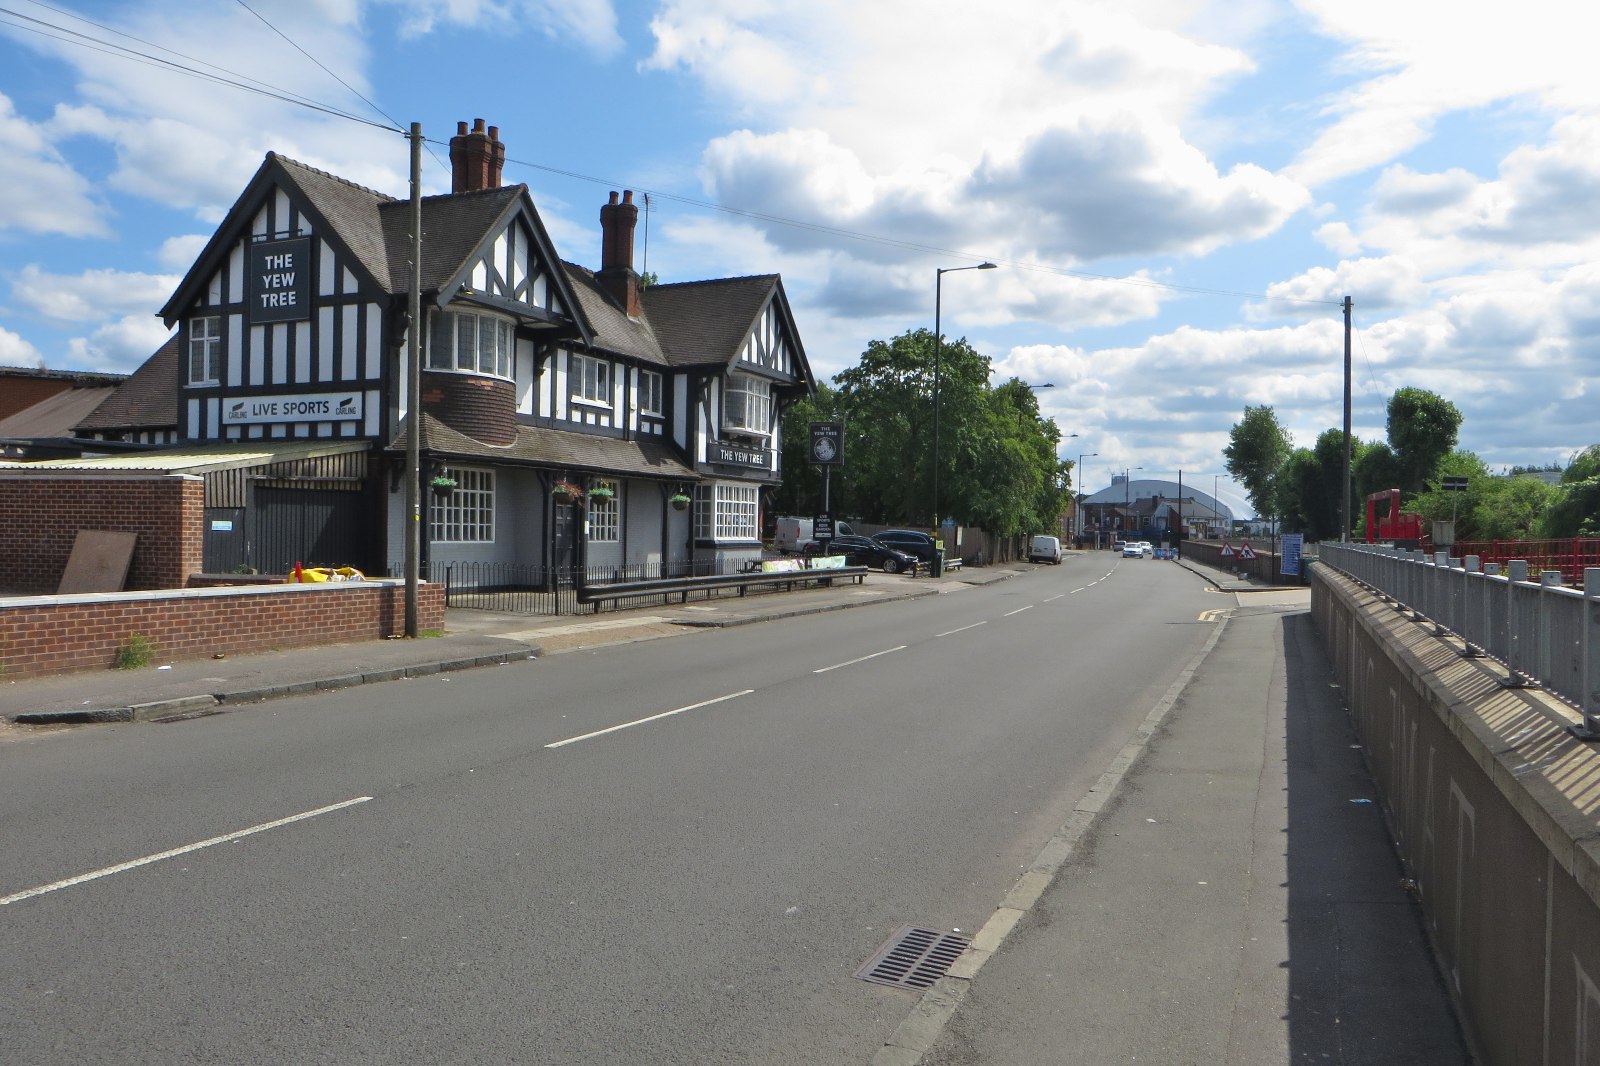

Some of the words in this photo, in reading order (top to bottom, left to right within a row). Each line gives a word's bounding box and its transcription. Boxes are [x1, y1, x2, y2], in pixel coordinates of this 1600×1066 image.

[265, 253, 293, 270] THE
[262, 272, 296, 289] YEW
[260, 291, 297, 308] TREE
[228, 411, 248, 420] CARLING
[252, 403, 278, 416] LIVE
[283, 401, 330, 415] SPORTS
[335, 407, 357, 416] CARLING
[720, 449, 733, 461] THE
[734, 451, 748, 463] YEW
[749, 453, 764, 465] TREE
